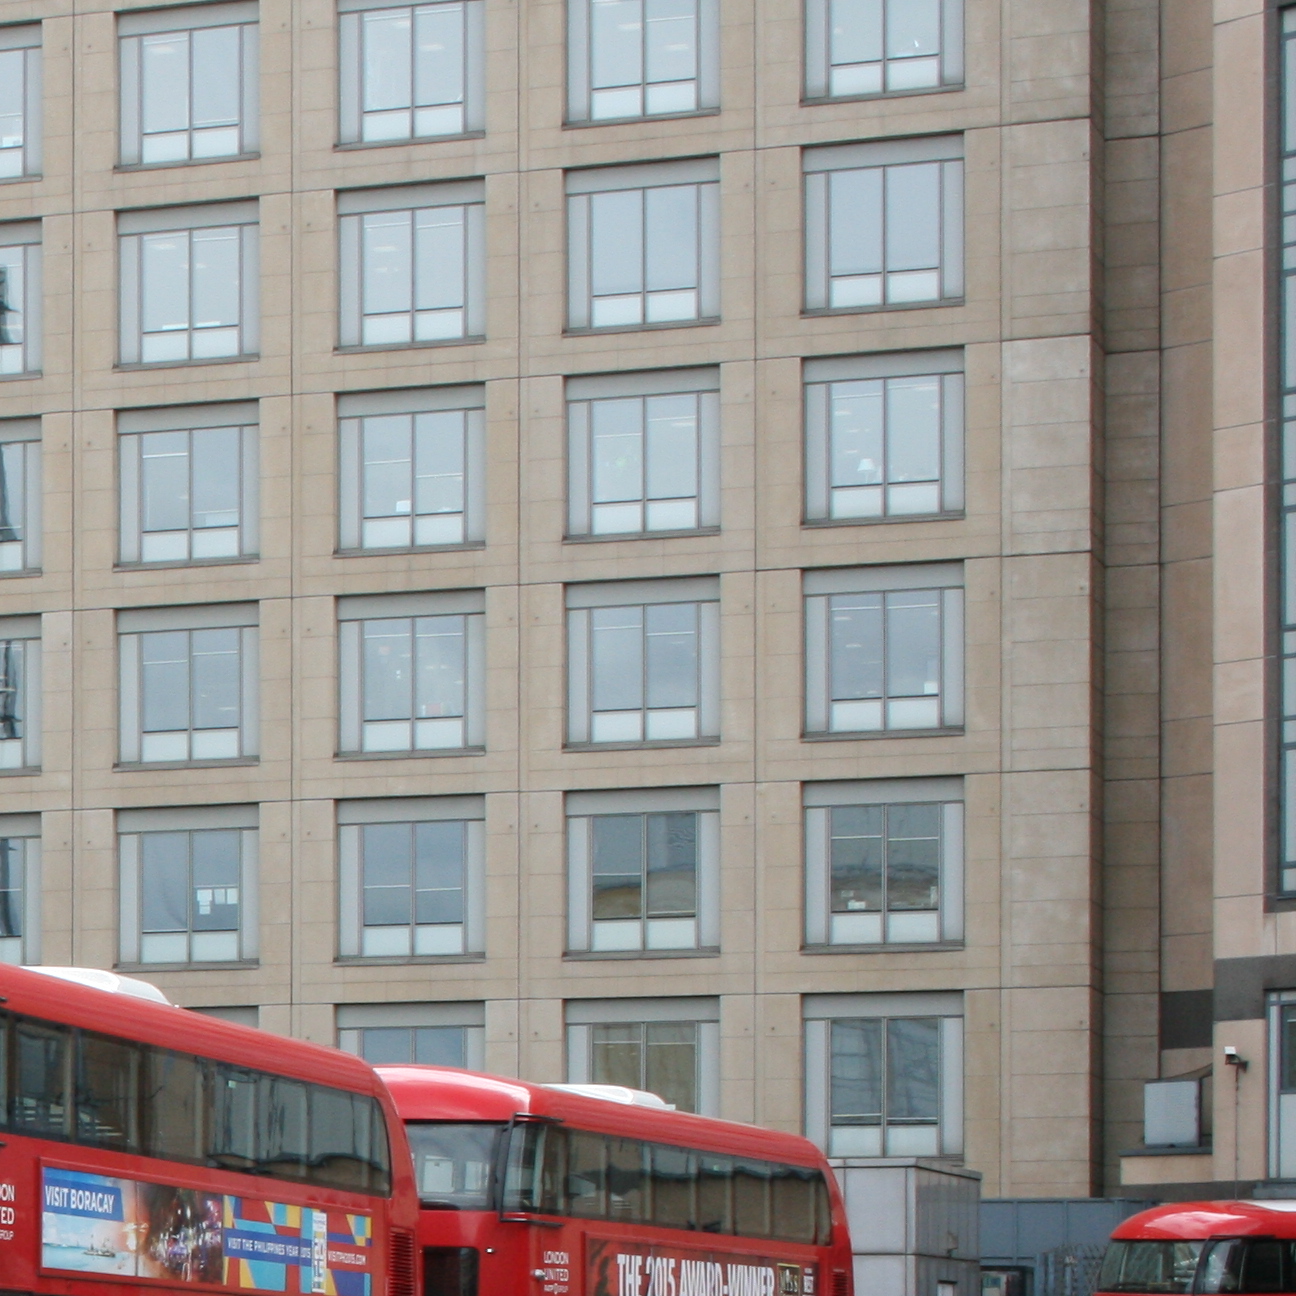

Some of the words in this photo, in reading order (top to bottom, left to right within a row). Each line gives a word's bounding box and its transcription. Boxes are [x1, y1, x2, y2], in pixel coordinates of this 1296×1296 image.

[45, 1184, 68, 1208] VISIT
[70, 1188, 114, 1214] BORACAY
[227, 1237, 241, 1250] VISIT
[242, 1239, 254, 1251] THE
